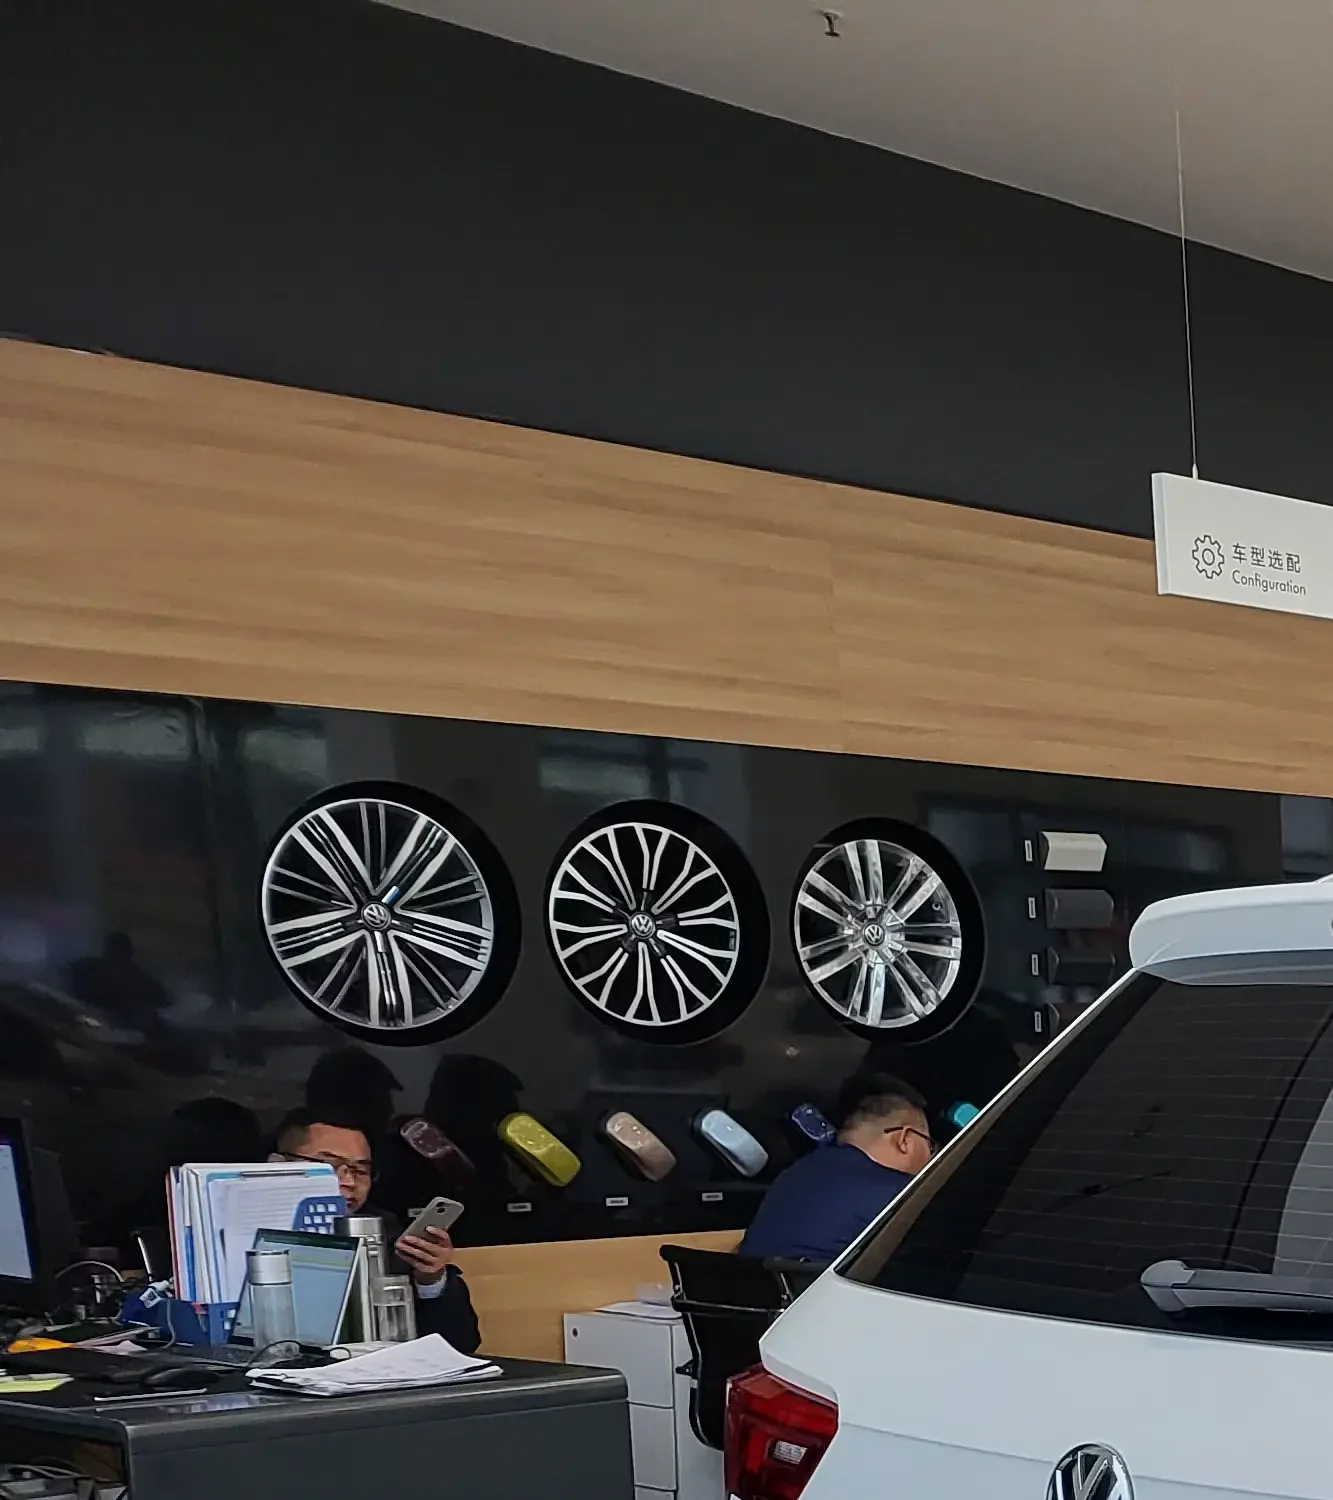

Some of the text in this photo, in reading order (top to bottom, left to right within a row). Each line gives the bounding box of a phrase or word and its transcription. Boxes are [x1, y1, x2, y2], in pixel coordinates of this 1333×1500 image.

[1231, 542, 1301, 574] 车型选配
[1231, 569, 1307, 596] Configuration
